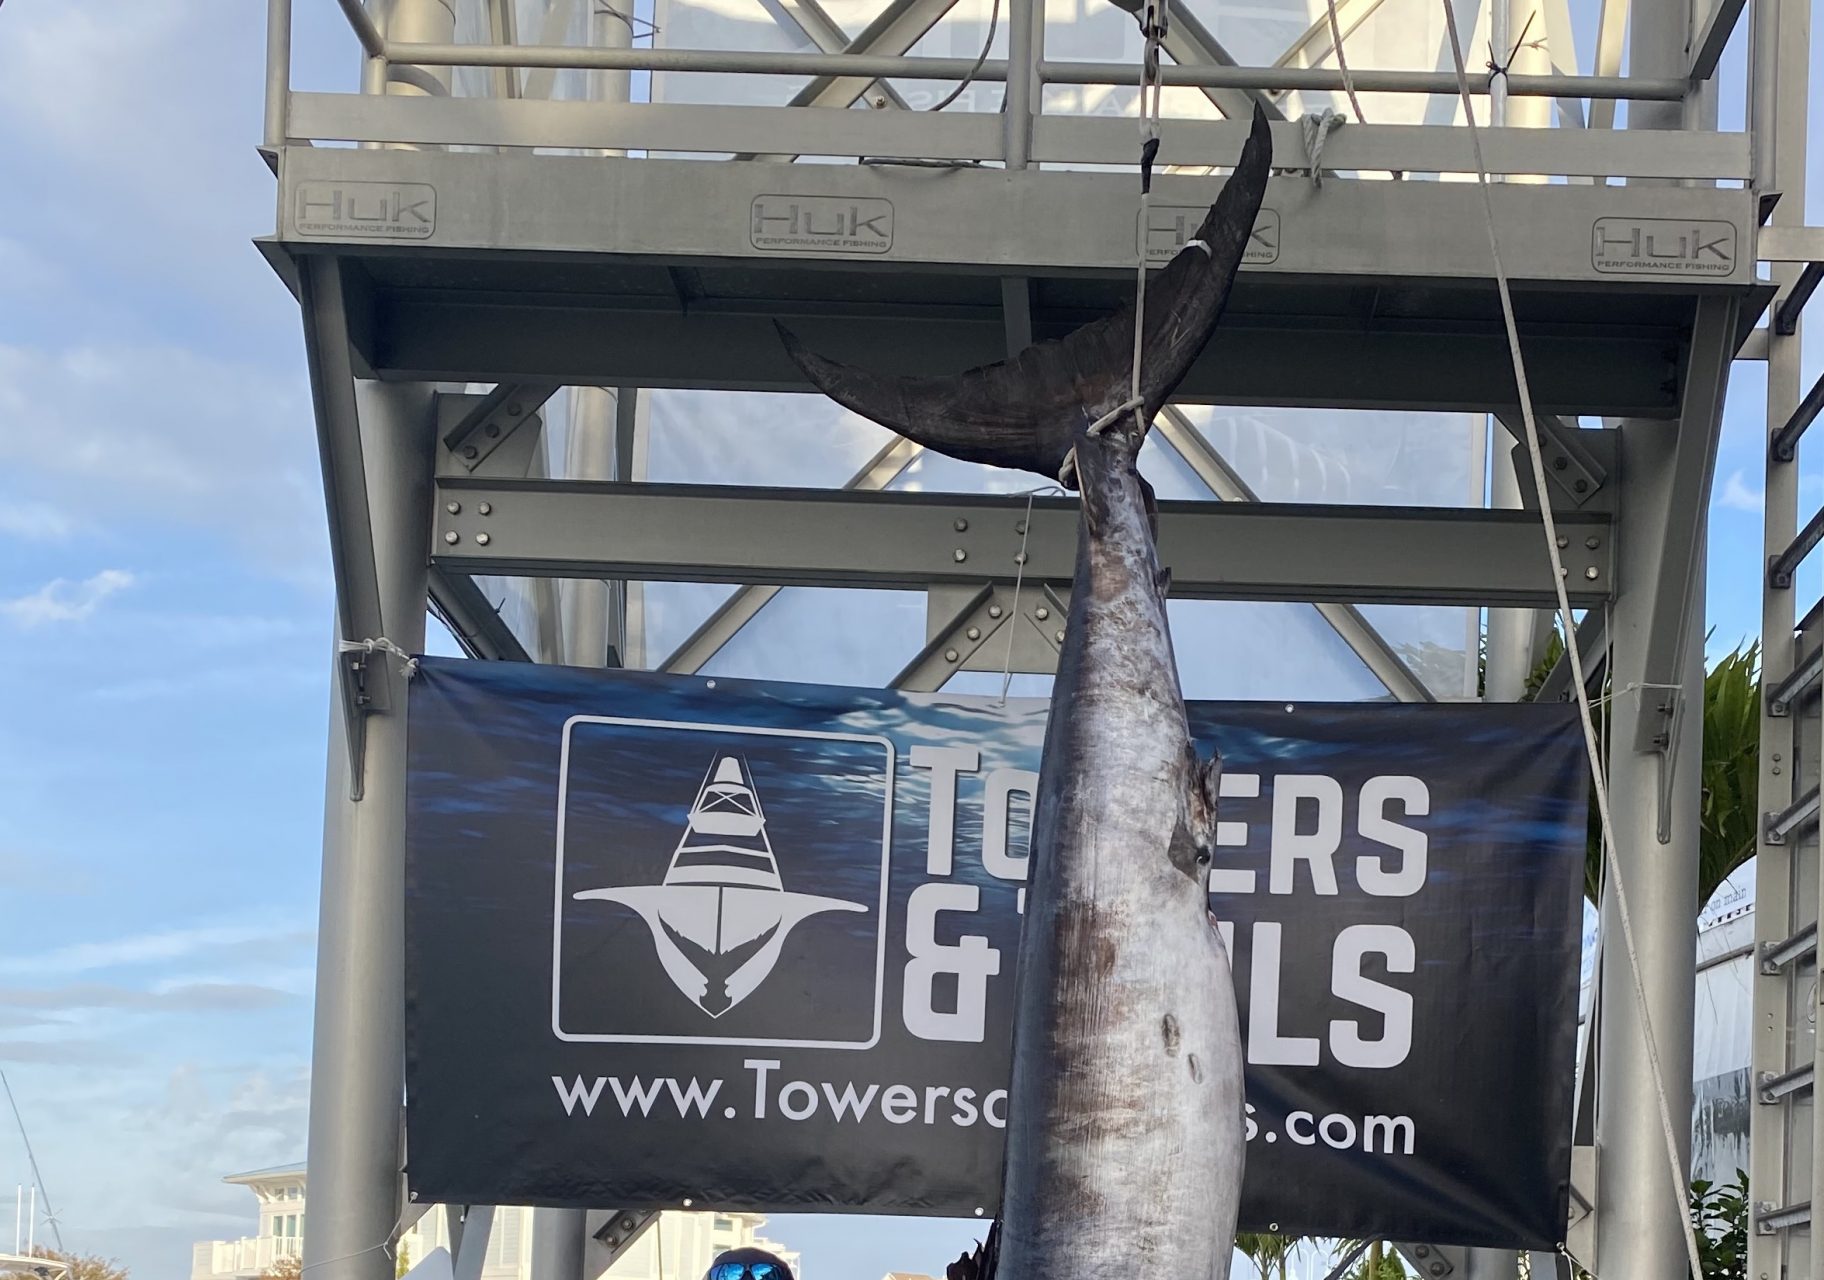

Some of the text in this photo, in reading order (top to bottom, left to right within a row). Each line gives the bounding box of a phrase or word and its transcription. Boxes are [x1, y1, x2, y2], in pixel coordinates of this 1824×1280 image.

[299, 223, 429, 234] PERFORMANCE FISHING
[755, 237, 887, 248] PERFORMANCE FISHING
[1597, 260, 1730, 271] PERFORMANCE FISHING
[909, 744, 1431, 898] TOERS
